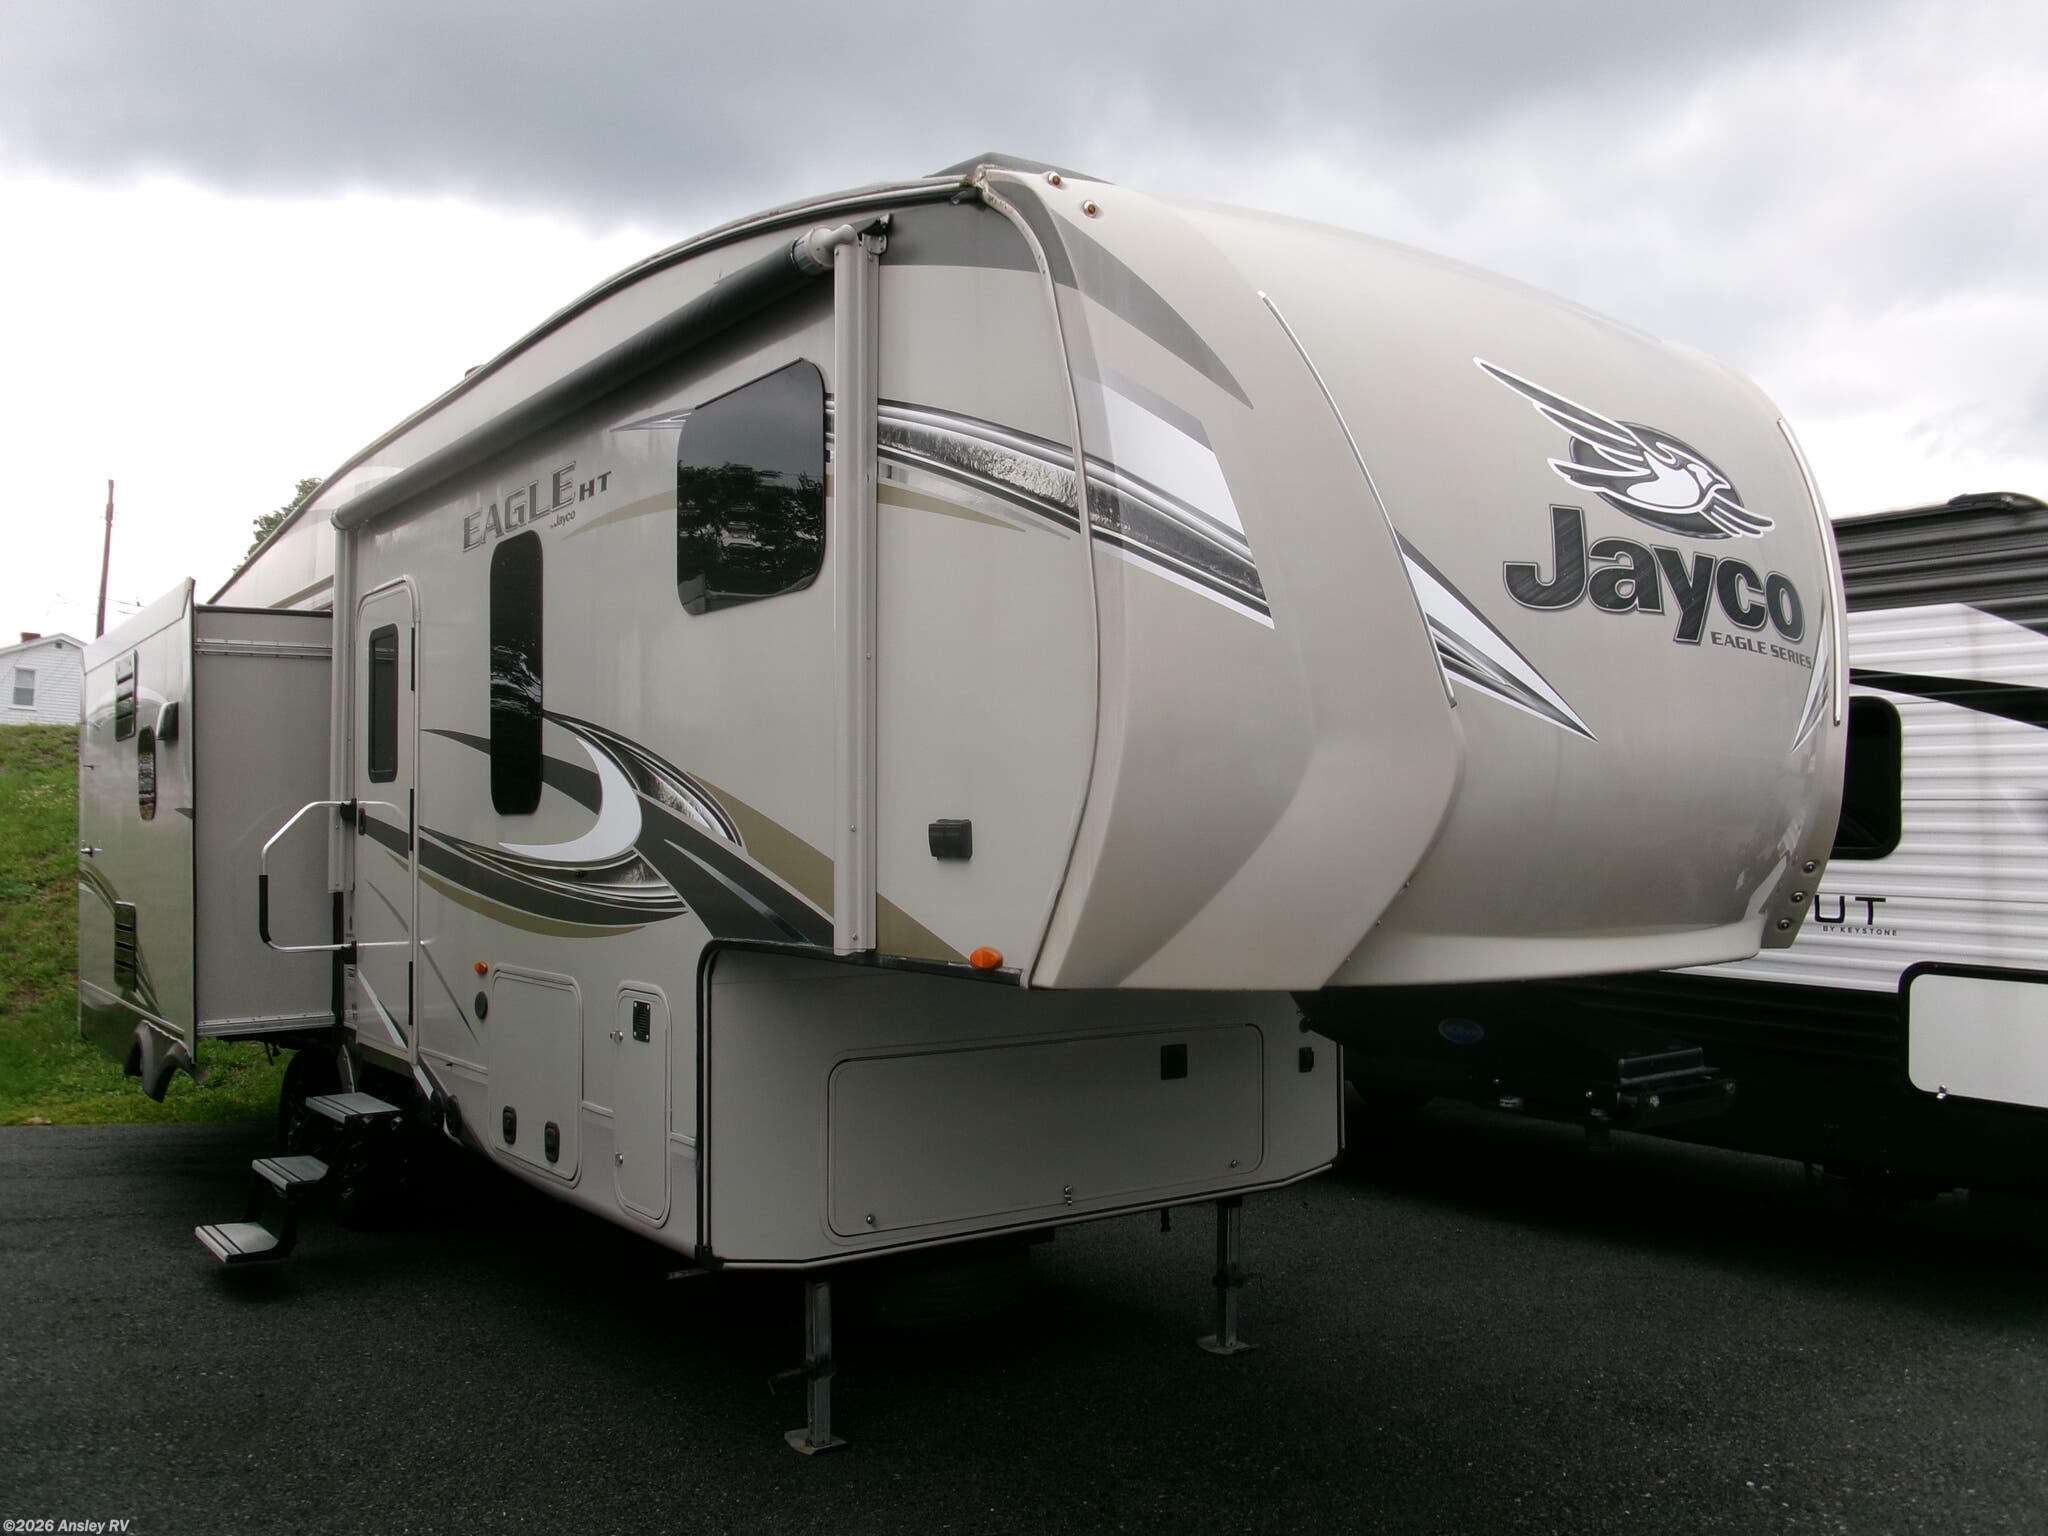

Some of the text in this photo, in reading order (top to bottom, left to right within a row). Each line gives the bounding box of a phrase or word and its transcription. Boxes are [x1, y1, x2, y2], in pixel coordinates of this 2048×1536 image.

[463, 460, 612, 552] EAGLE HT
[554, 510, 576, 528] Jayco
[1502, 503, 1806, 645] Jayco
[1710, 631, 1812, 669] EAGLE SERIES
[1840, 926, 1897, 937] KEYSTONE
